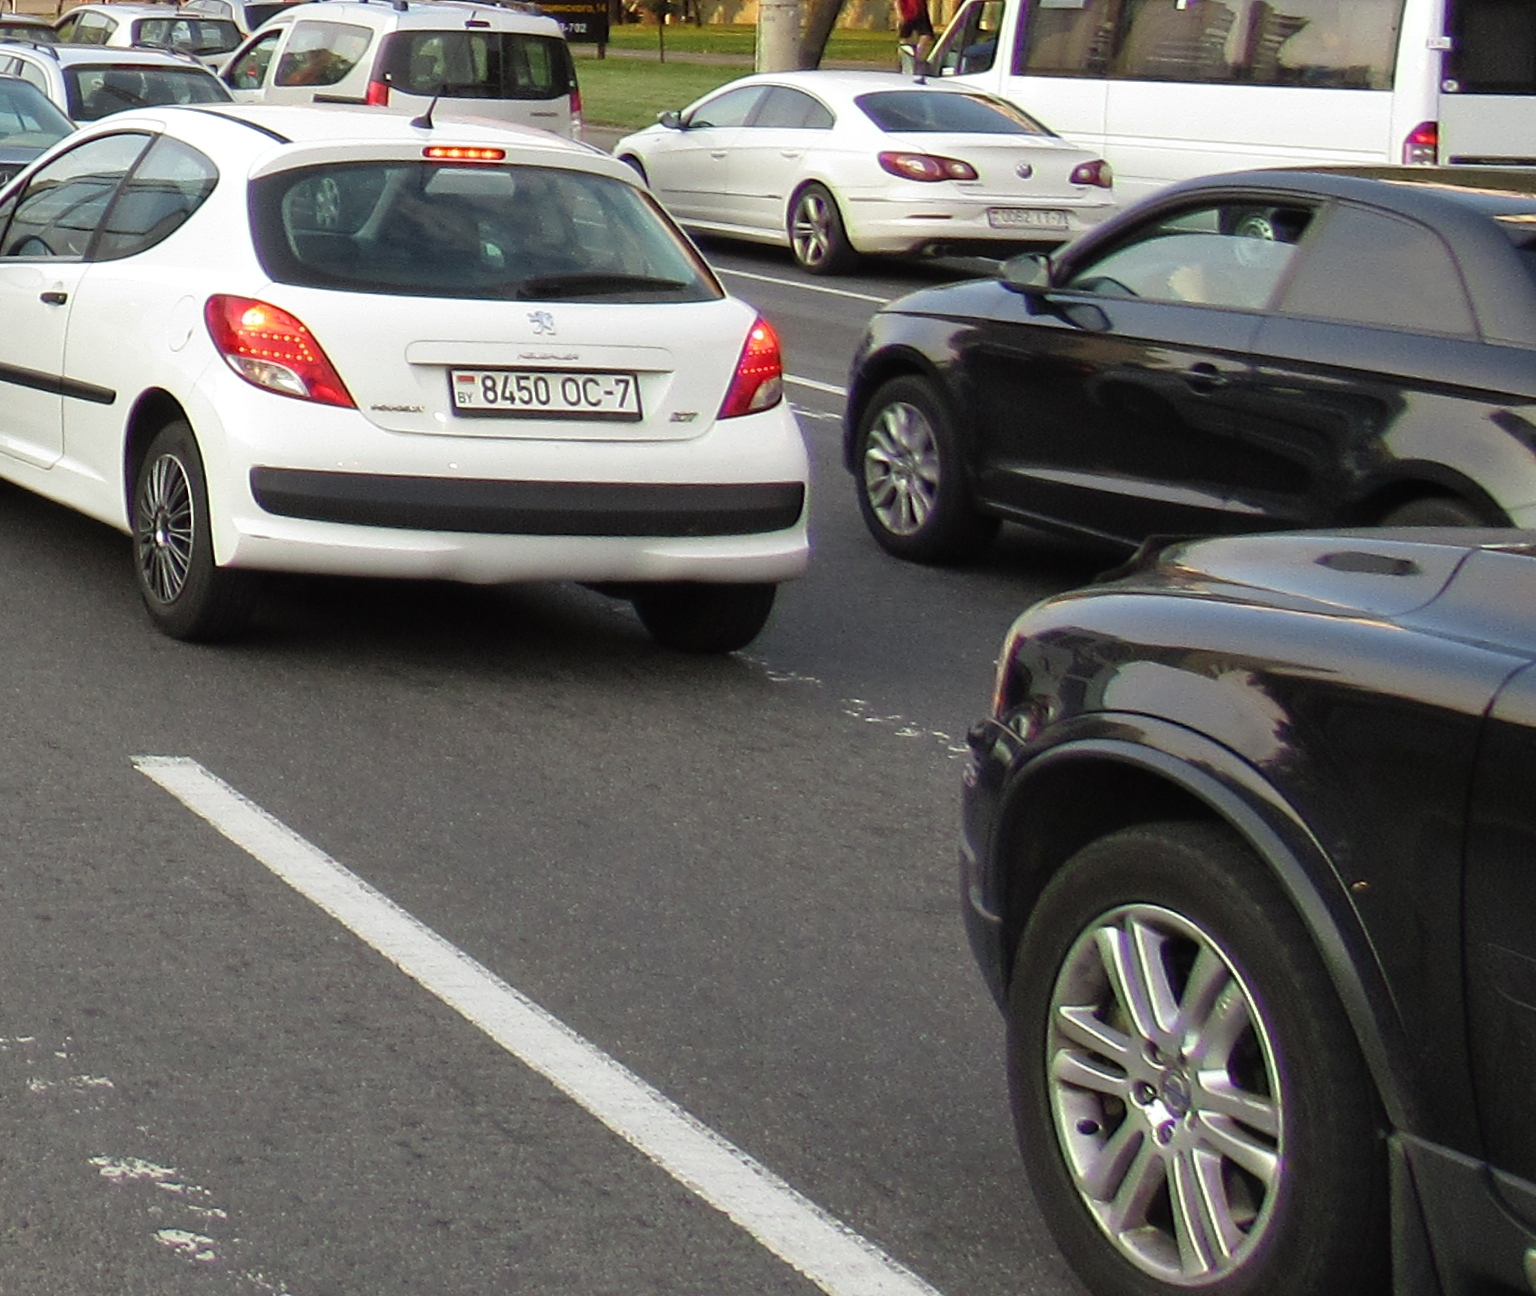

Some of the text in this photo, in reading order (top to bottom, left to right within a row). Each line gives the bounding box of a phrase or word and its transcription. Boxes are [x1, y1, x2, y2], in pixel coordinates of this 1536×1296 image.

[457, 391, 474, 404] BY
[481, 374, 631, 409] 8450 OC-7
